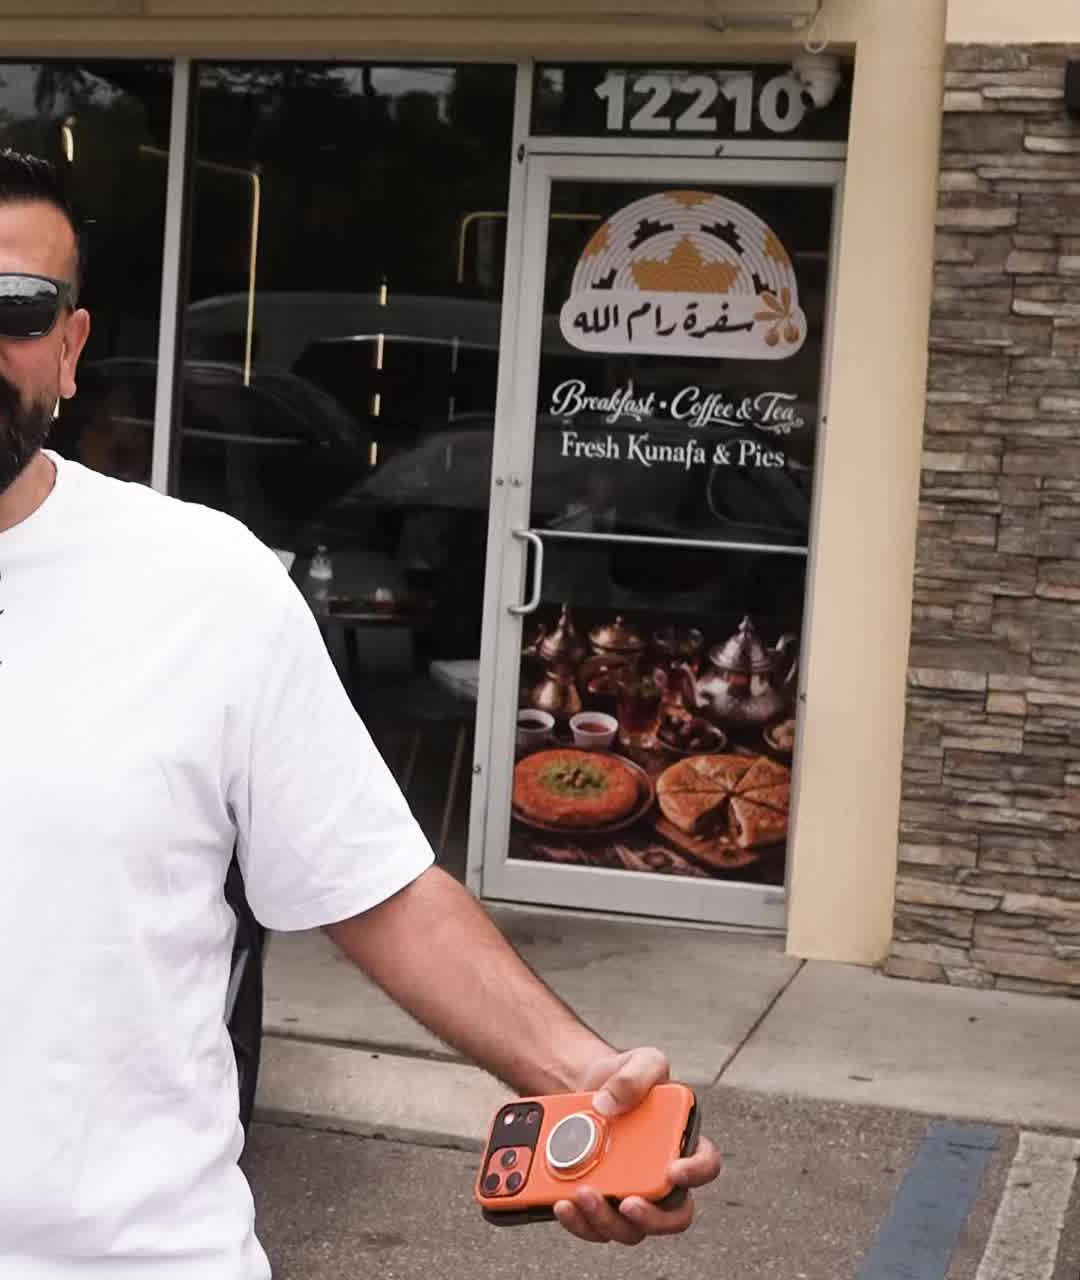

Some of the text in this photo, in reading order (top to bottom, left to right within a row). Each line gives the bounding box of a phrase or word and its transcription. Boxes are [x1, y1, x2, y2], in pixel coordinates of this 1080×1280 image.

[594, 71, 808, 134] 12210
[573, 301, 755, 342] سفرة رام الله
[550, 378, 805, 434] Breakfast Coffee & Tea
[561, 431, 785, 470] Fresh Kunafa & Pies
